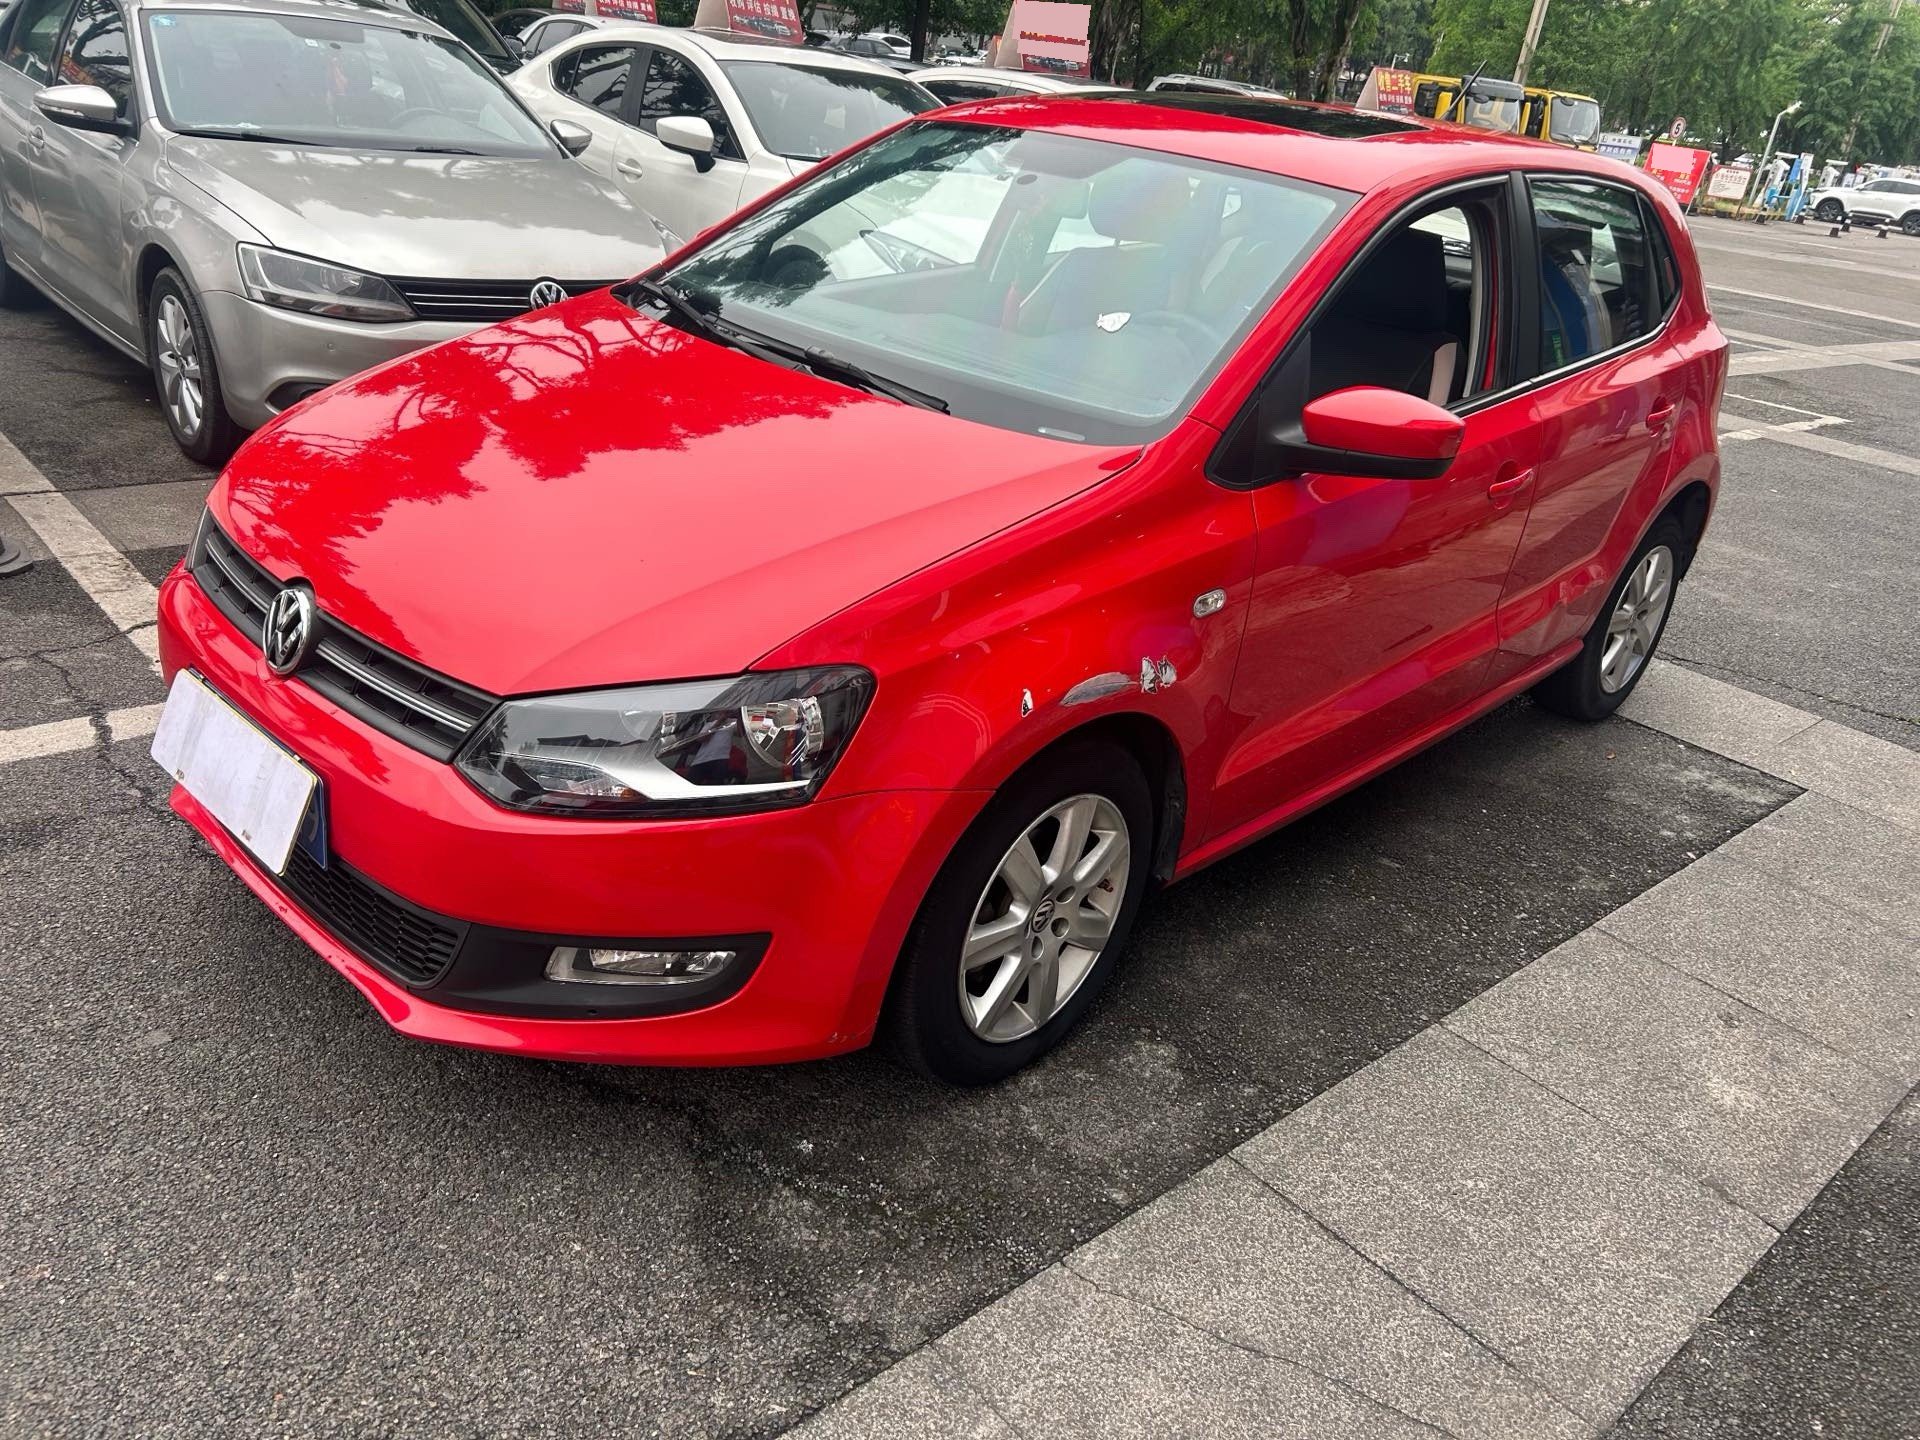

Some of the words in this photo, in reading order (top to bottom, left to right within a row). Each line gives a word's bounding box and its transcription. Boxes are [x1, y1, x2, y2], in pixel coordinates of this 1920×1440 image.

[1378, 71, 1412, 94] 收售二手车
[1674, 123, 1680, 135] 5
